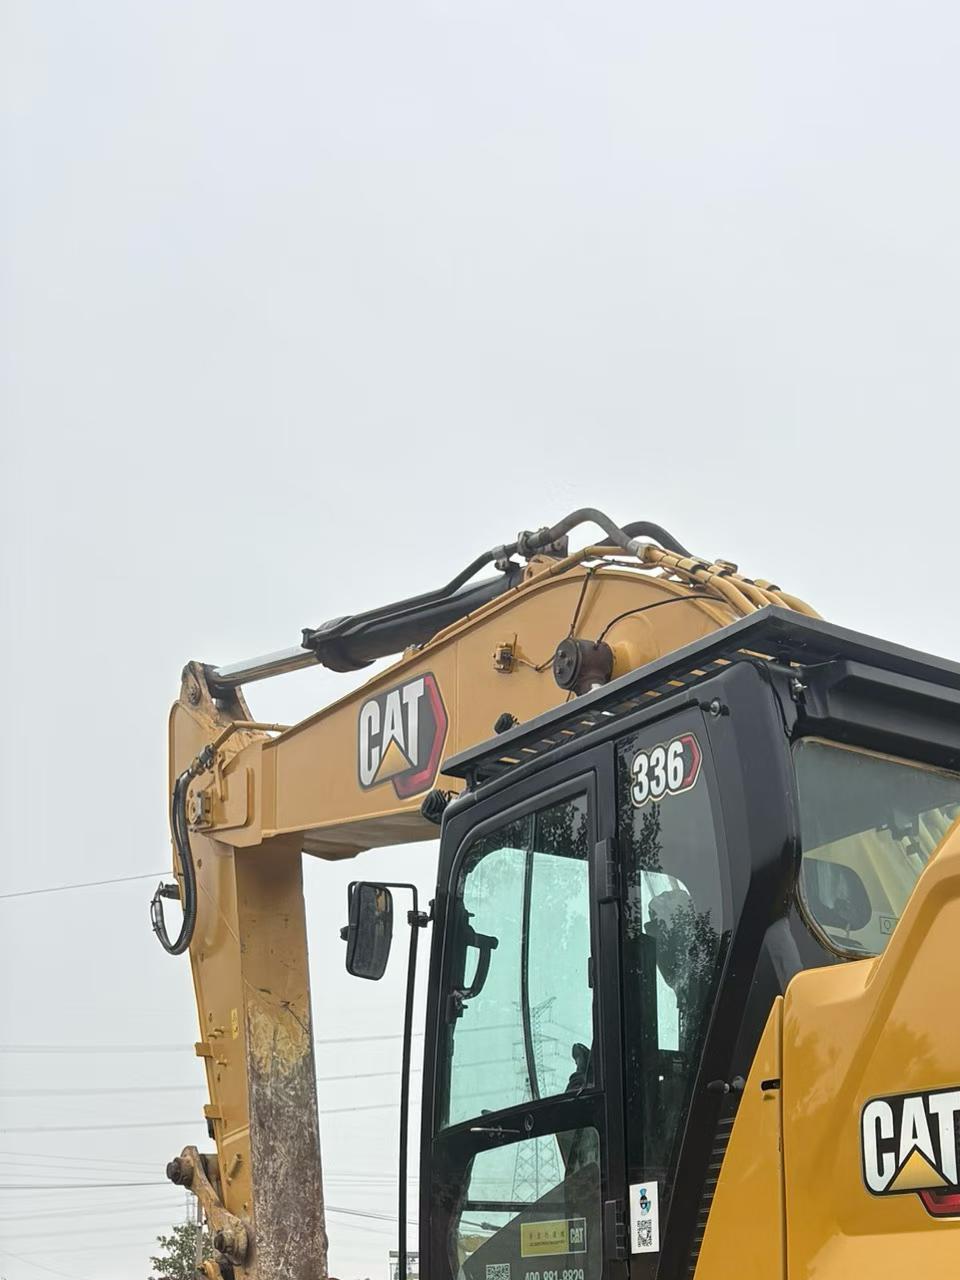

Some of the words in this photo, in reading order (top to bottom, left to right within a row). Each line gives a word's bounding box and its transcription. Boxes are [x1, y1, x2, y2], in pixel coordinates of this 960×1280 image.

[360, 678, 425, 786] CAT
[633, 741, 684, 802] 336
[570, 1227, 584, 1244] CAT
